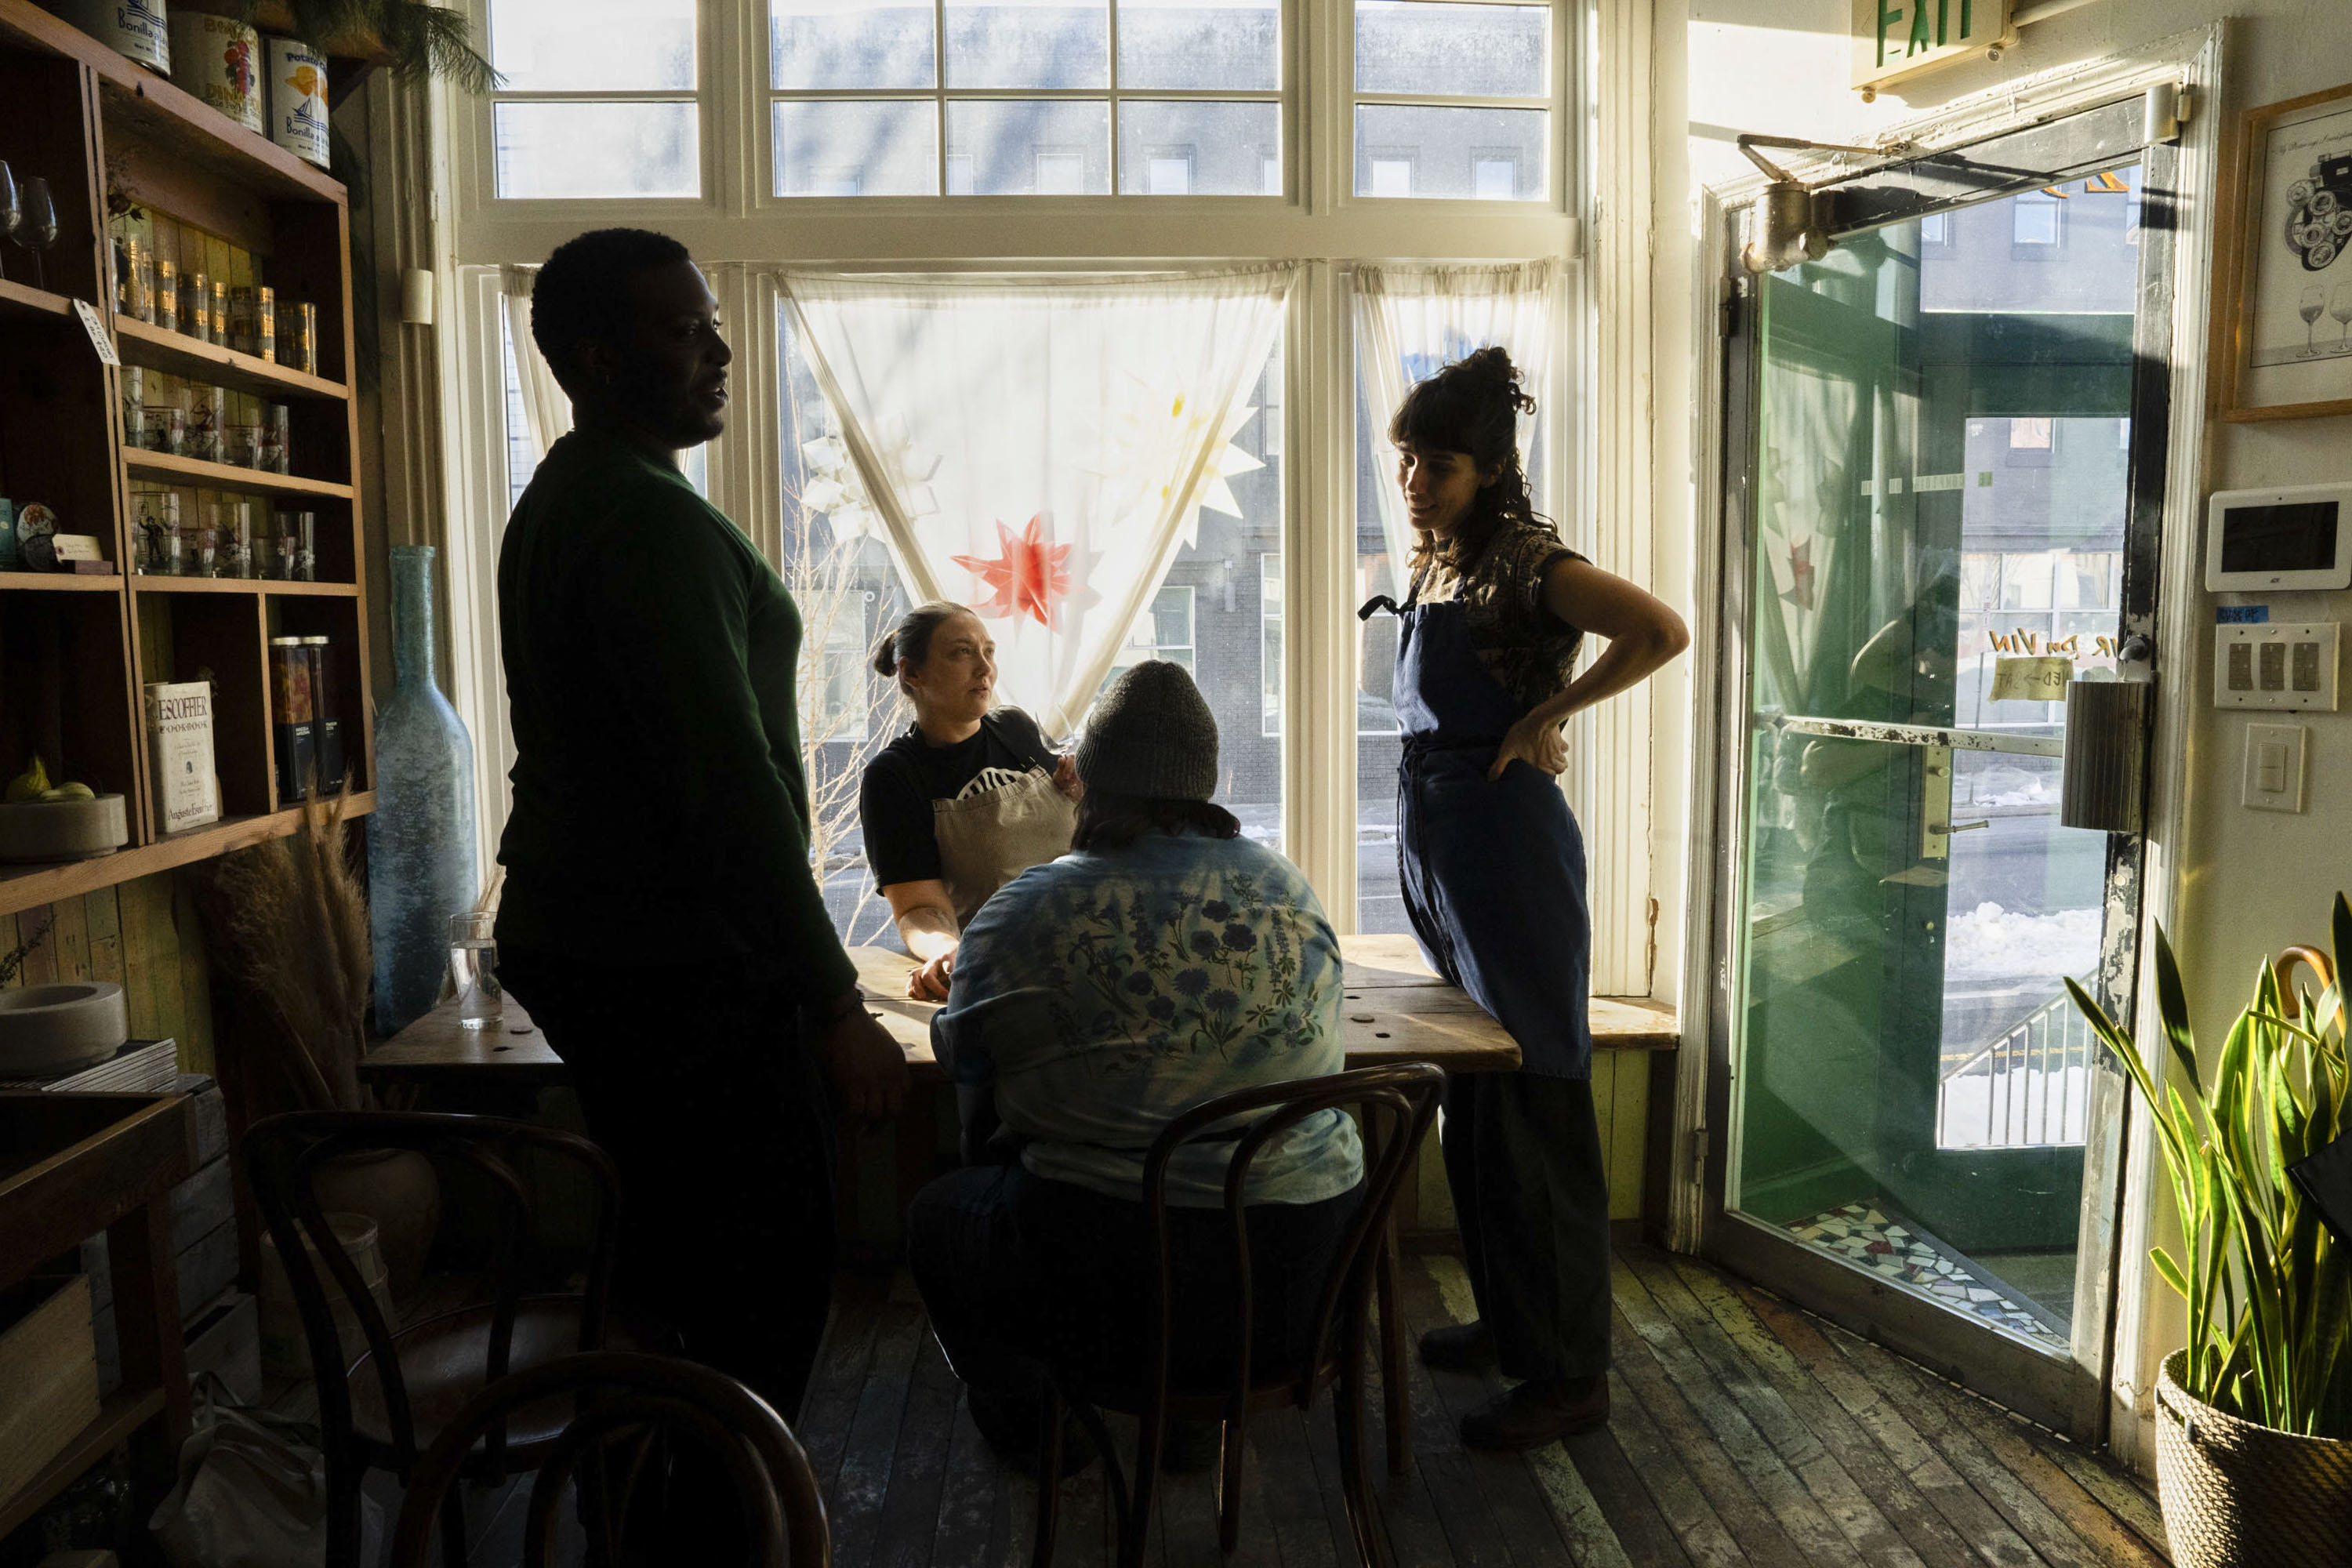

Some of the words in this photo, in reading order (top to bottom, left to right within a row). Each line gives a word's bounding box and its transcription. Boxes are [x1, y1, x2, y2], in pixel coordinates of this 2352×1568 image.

[118, 6, 153, 38] Bonilla
[286, 52, 318, 66] Potato
[286, 116, 314, 140] Bonilla
[157, 696, 207, 720] ESCOFFIER
